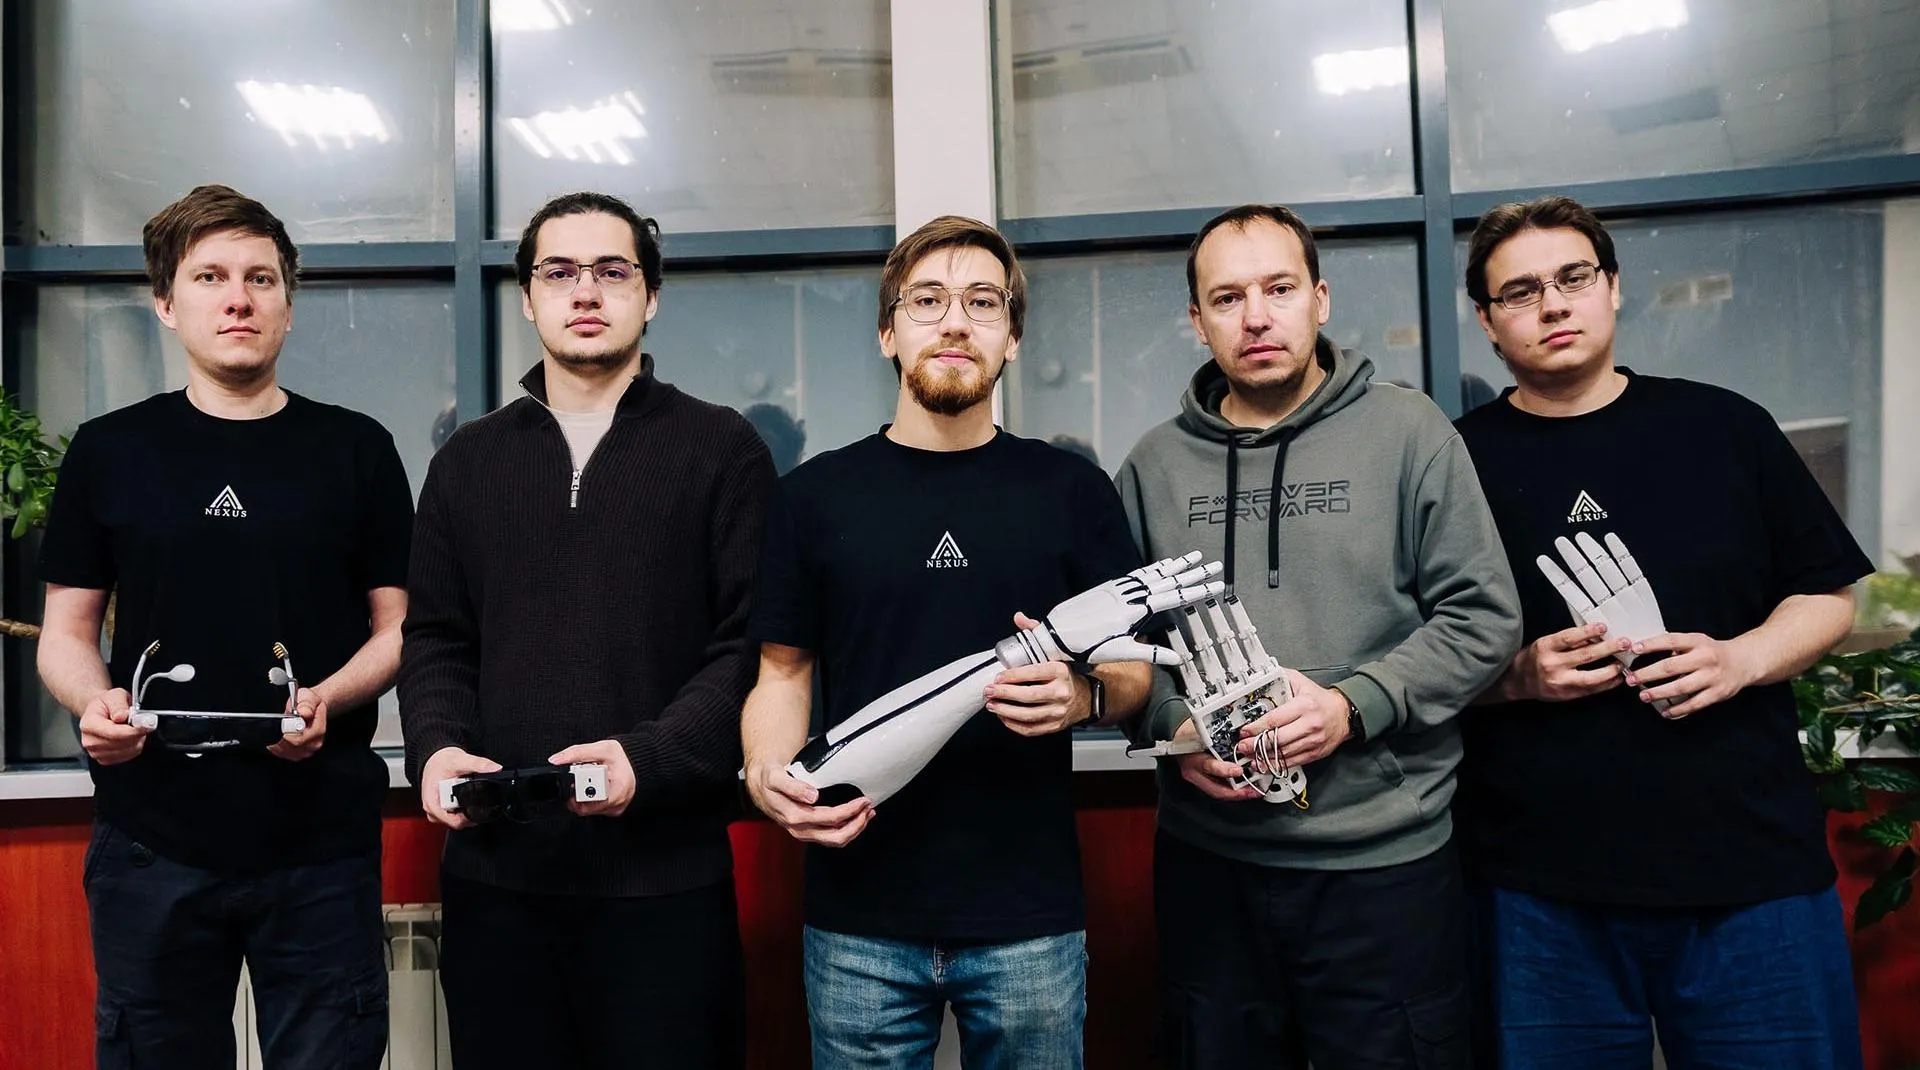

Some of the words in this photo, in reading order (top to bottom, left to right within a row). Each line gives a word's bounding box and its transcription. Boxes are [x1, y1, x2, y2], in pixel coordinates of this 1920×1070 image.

[205, 507, 247, 518] NEXUS
[1567, 511, 1608, 524] NEXUS
[926, 558, 968, 569] NEXUS
